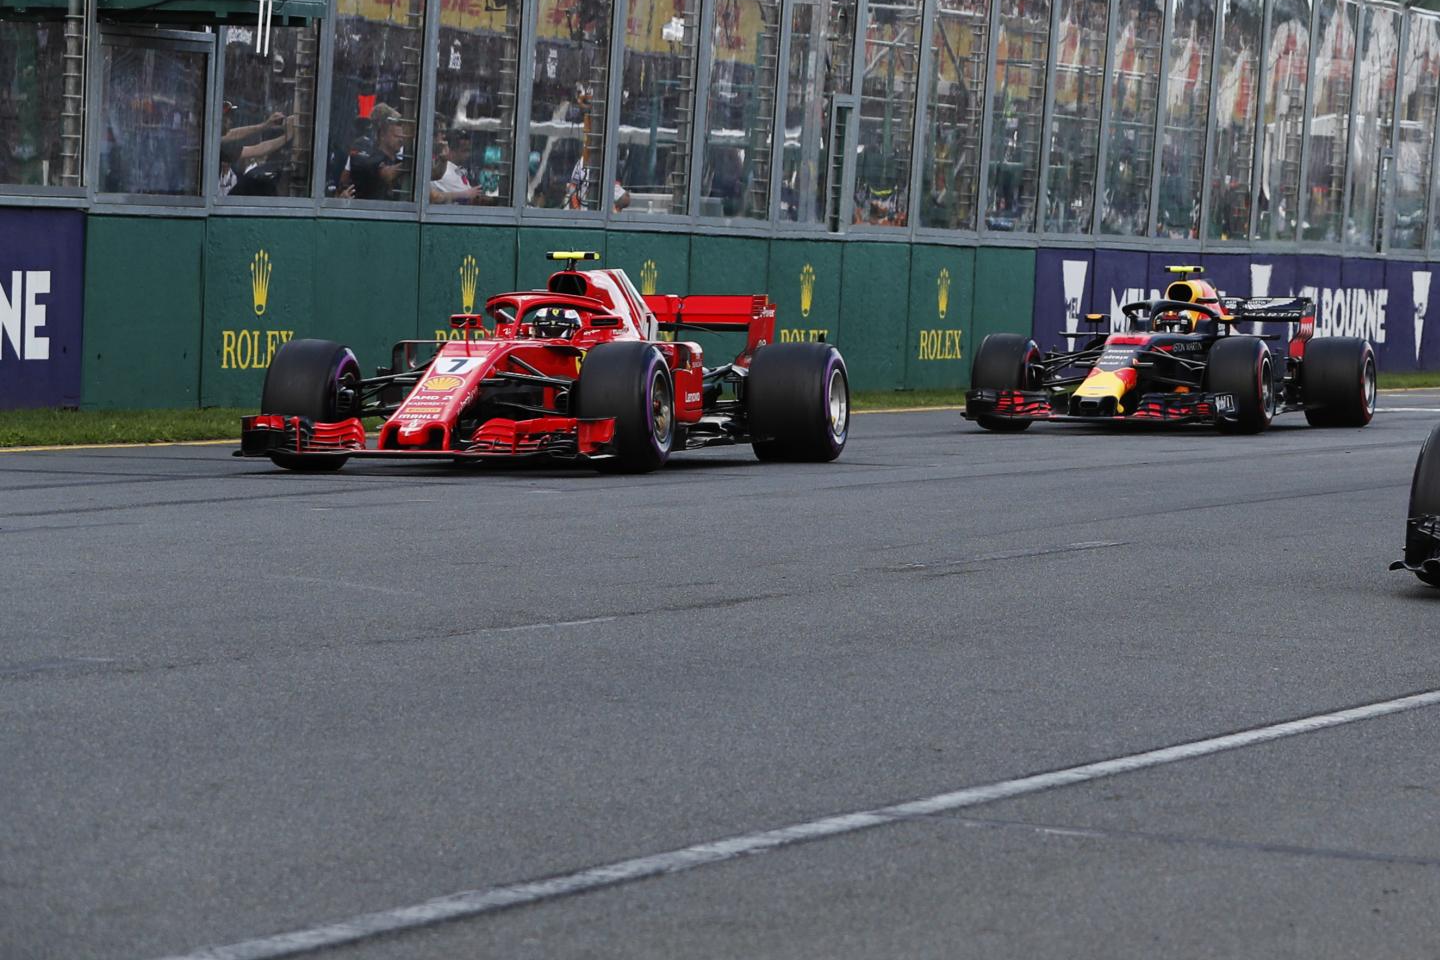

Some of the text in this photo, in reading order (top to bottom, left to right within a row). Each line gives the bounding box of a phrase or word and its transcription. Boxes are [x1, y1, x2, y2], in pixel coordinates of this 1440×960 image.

[221, 329, 294, 370] ROLE
[917, 329, 962, 360] ROLEX
[448, 358, 470, 373] 7
